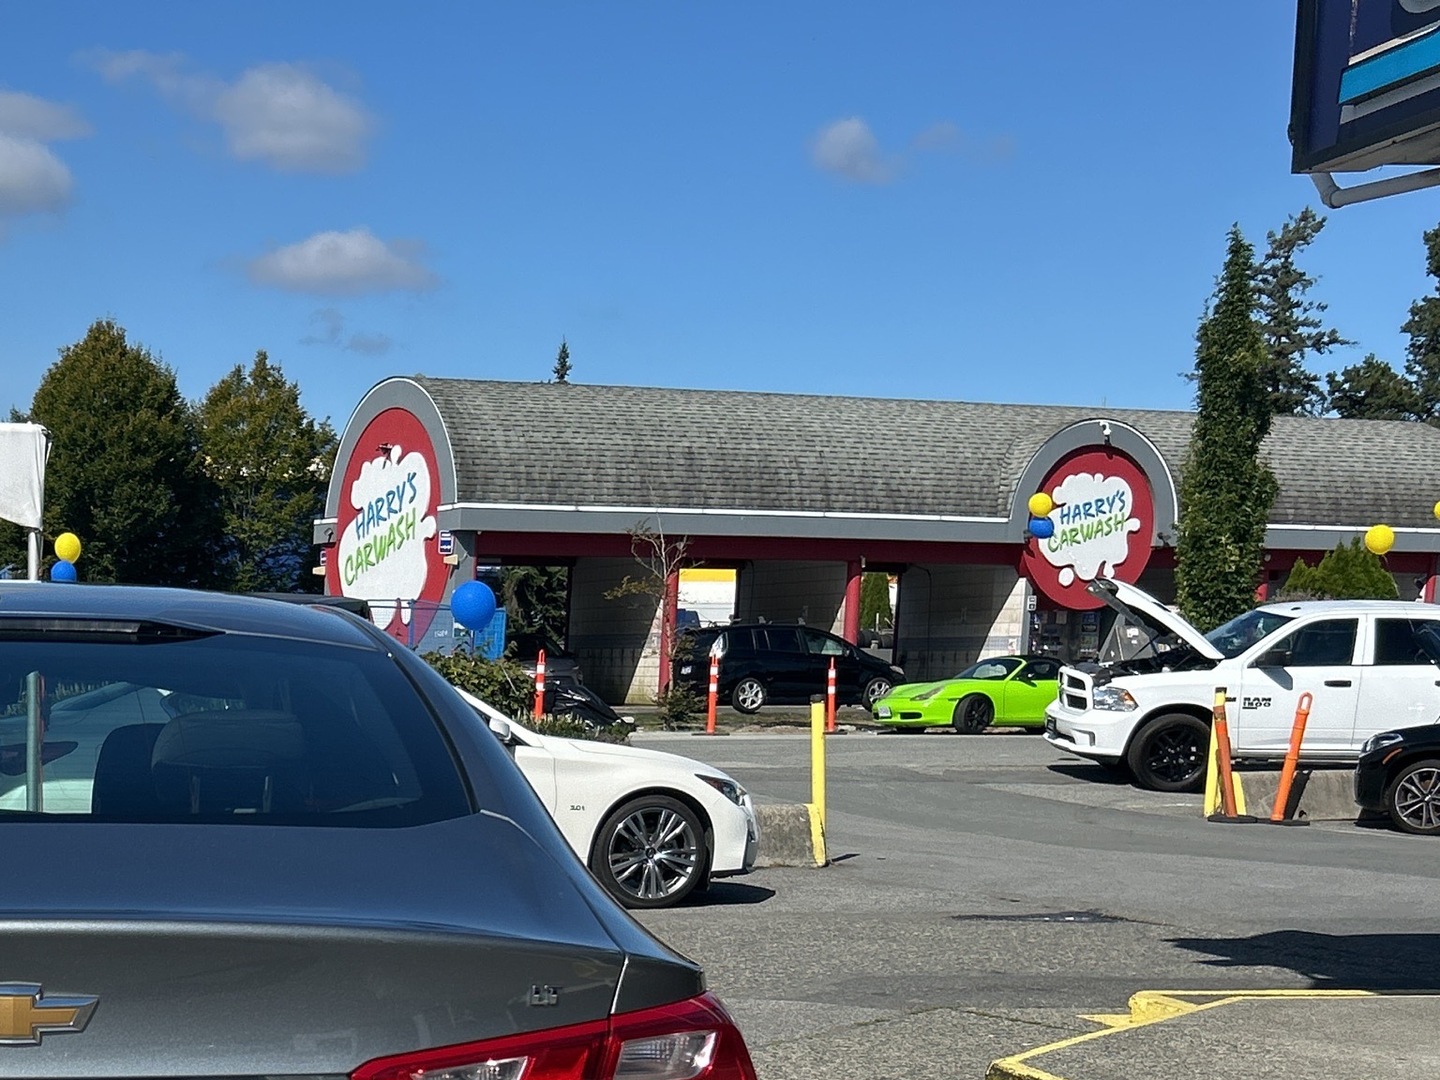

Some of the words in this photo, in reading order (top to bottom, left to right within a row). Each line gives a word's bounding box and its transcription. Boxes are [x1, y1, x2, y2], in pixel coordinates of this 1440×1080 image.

[355, 472, 417, 540] HARRY'S
[1048, 512, 1126, 552] CARWASH
[1060, 489, 1126, 525] HARRY'S
[345, 507, 416, 586] CARWASH
